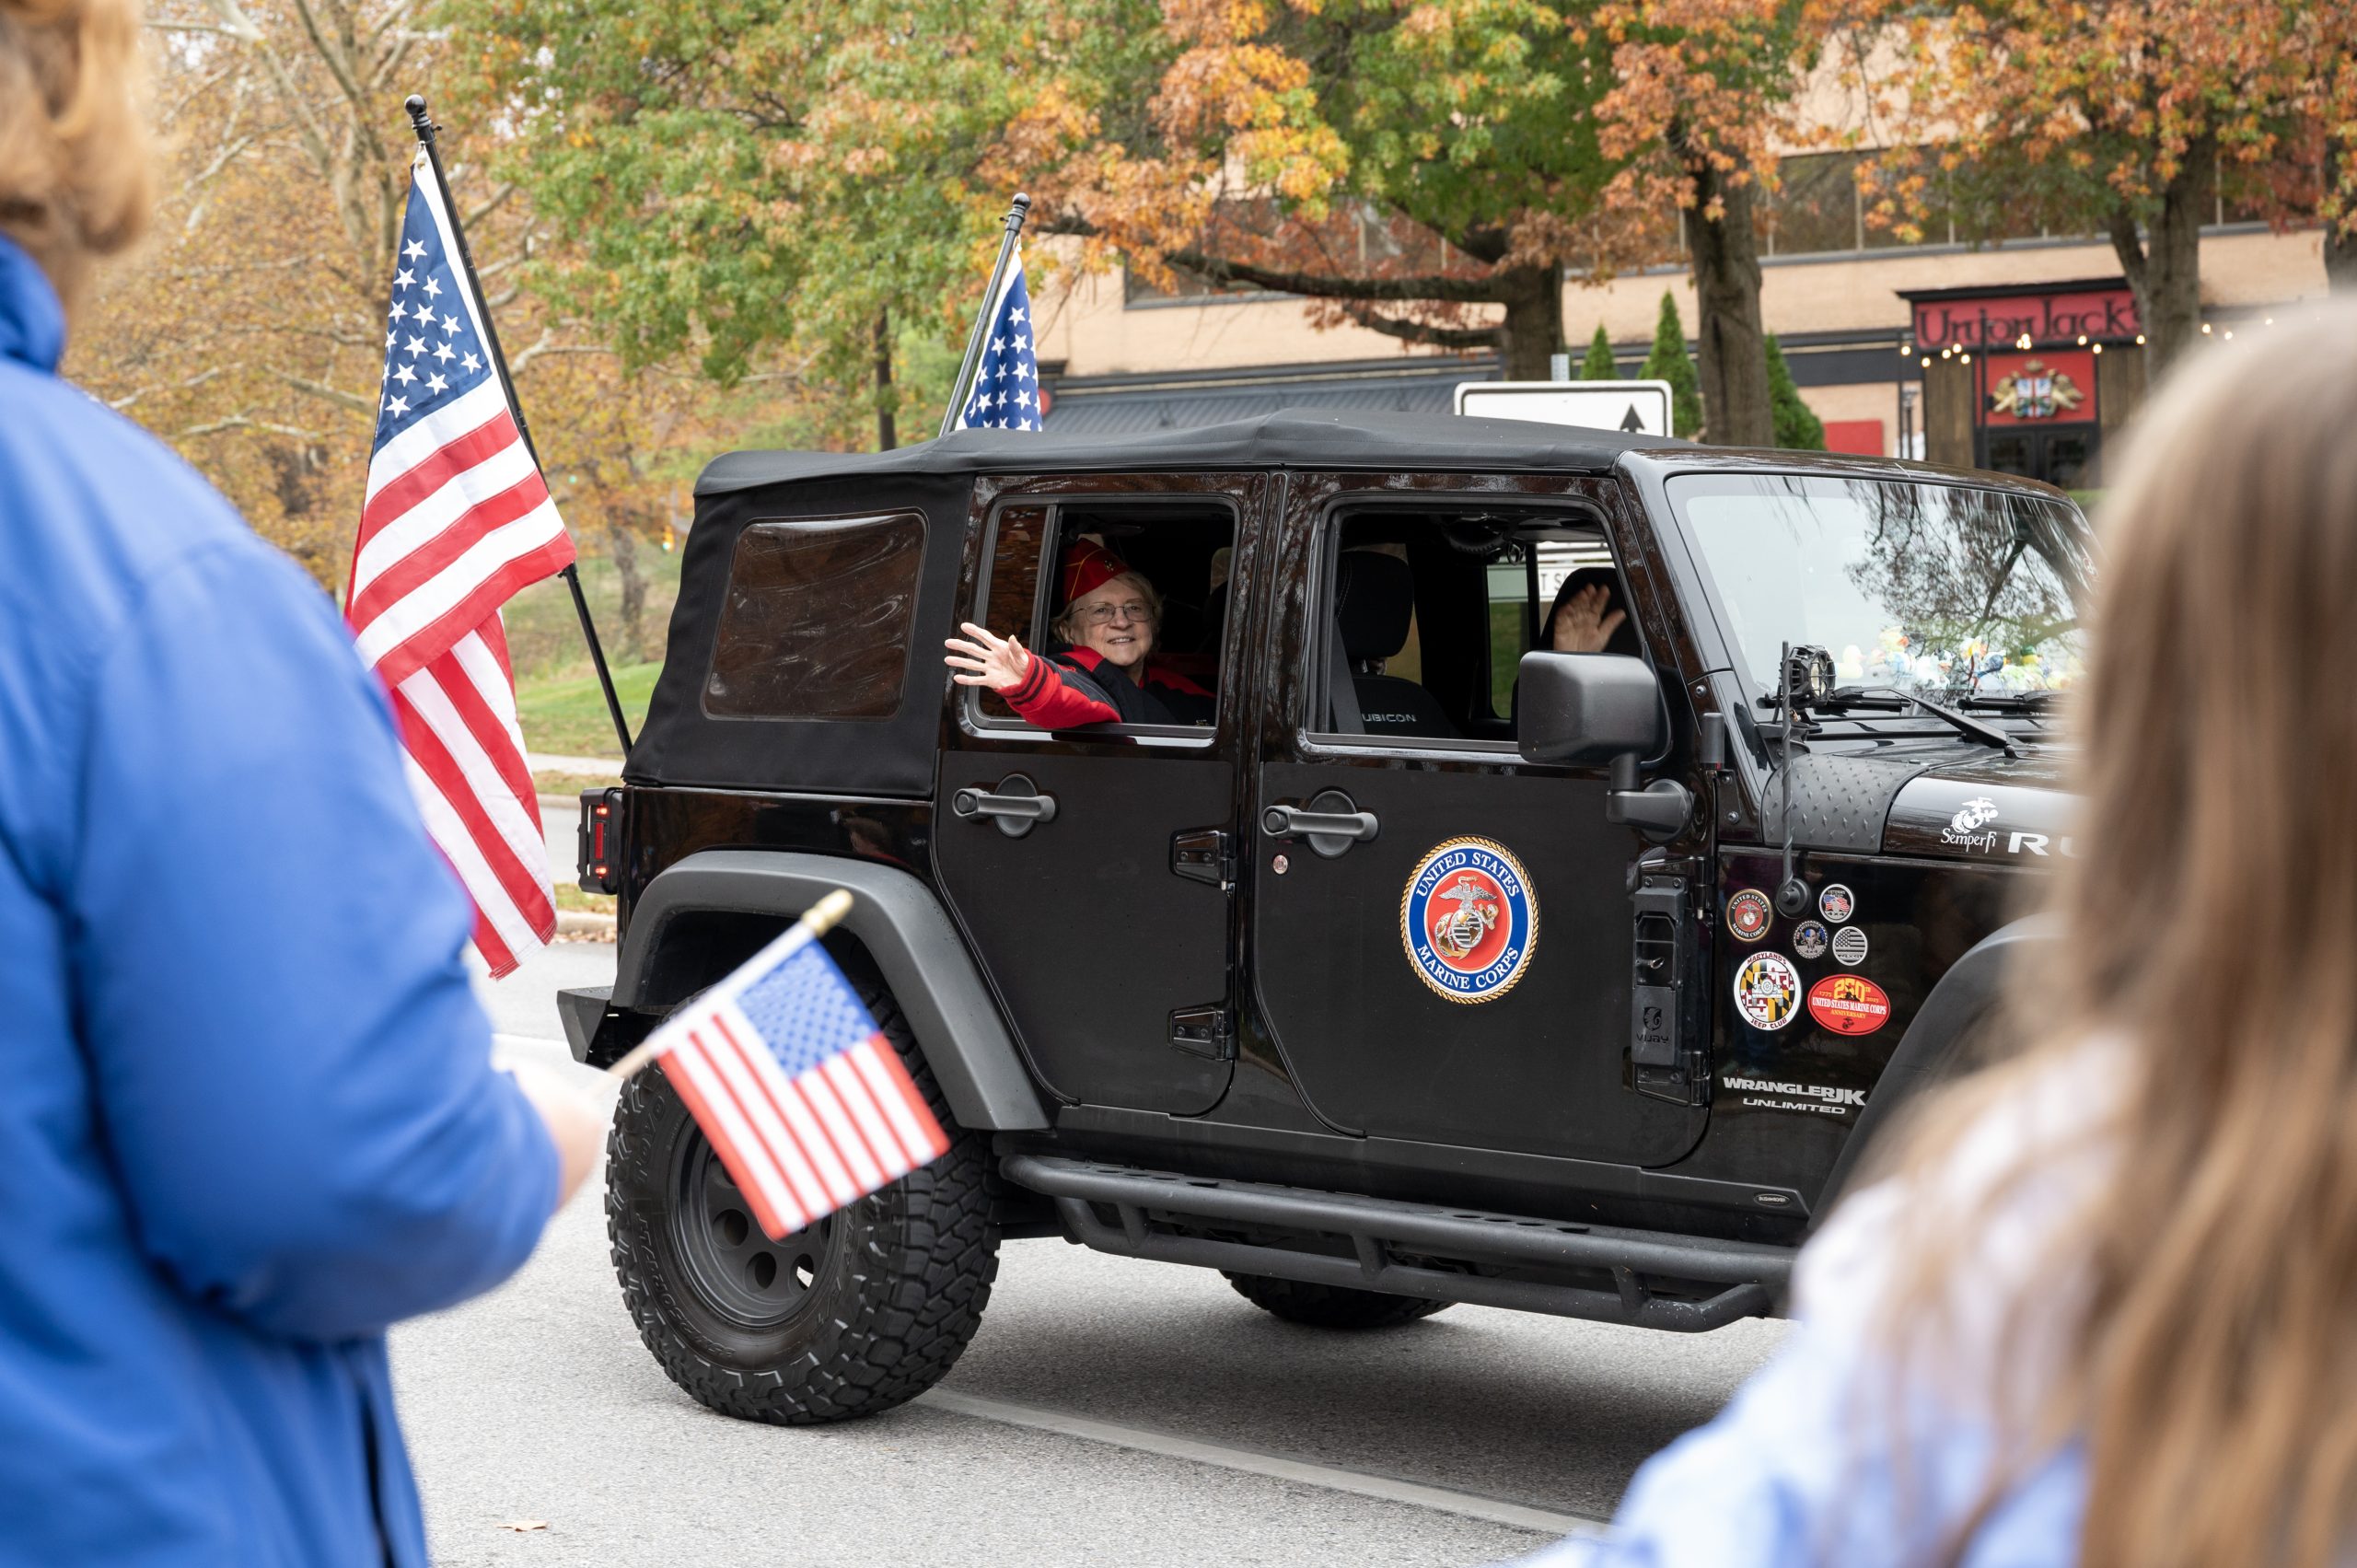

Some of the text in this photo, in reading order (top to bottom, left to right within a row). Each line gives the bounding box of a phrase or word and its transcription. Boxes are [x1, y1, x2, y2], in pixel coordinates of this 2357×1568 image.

[1361, 713, 1417, 723] UBICON
[1416, 852, 1520, 898] UNITED STATES
[1731, 894, 1768, 912] UNITED STATES
[1732, 923, 1766, 937] MARINE CORPS
[1417, 944, 1519, 990] MARINE CORPS
[1812, 996, 1887, 1016] UNITED STATES MARINE CORPS
[1830, 1009, 1868, 1019] ANNIVERSARY
[1751, 1016, 1787, 1029] JEEP CLUB
[1723, 1076, 1837, 1098] WRANGLER
[1742, 1098, 1846, 1115] UNLIMITED
